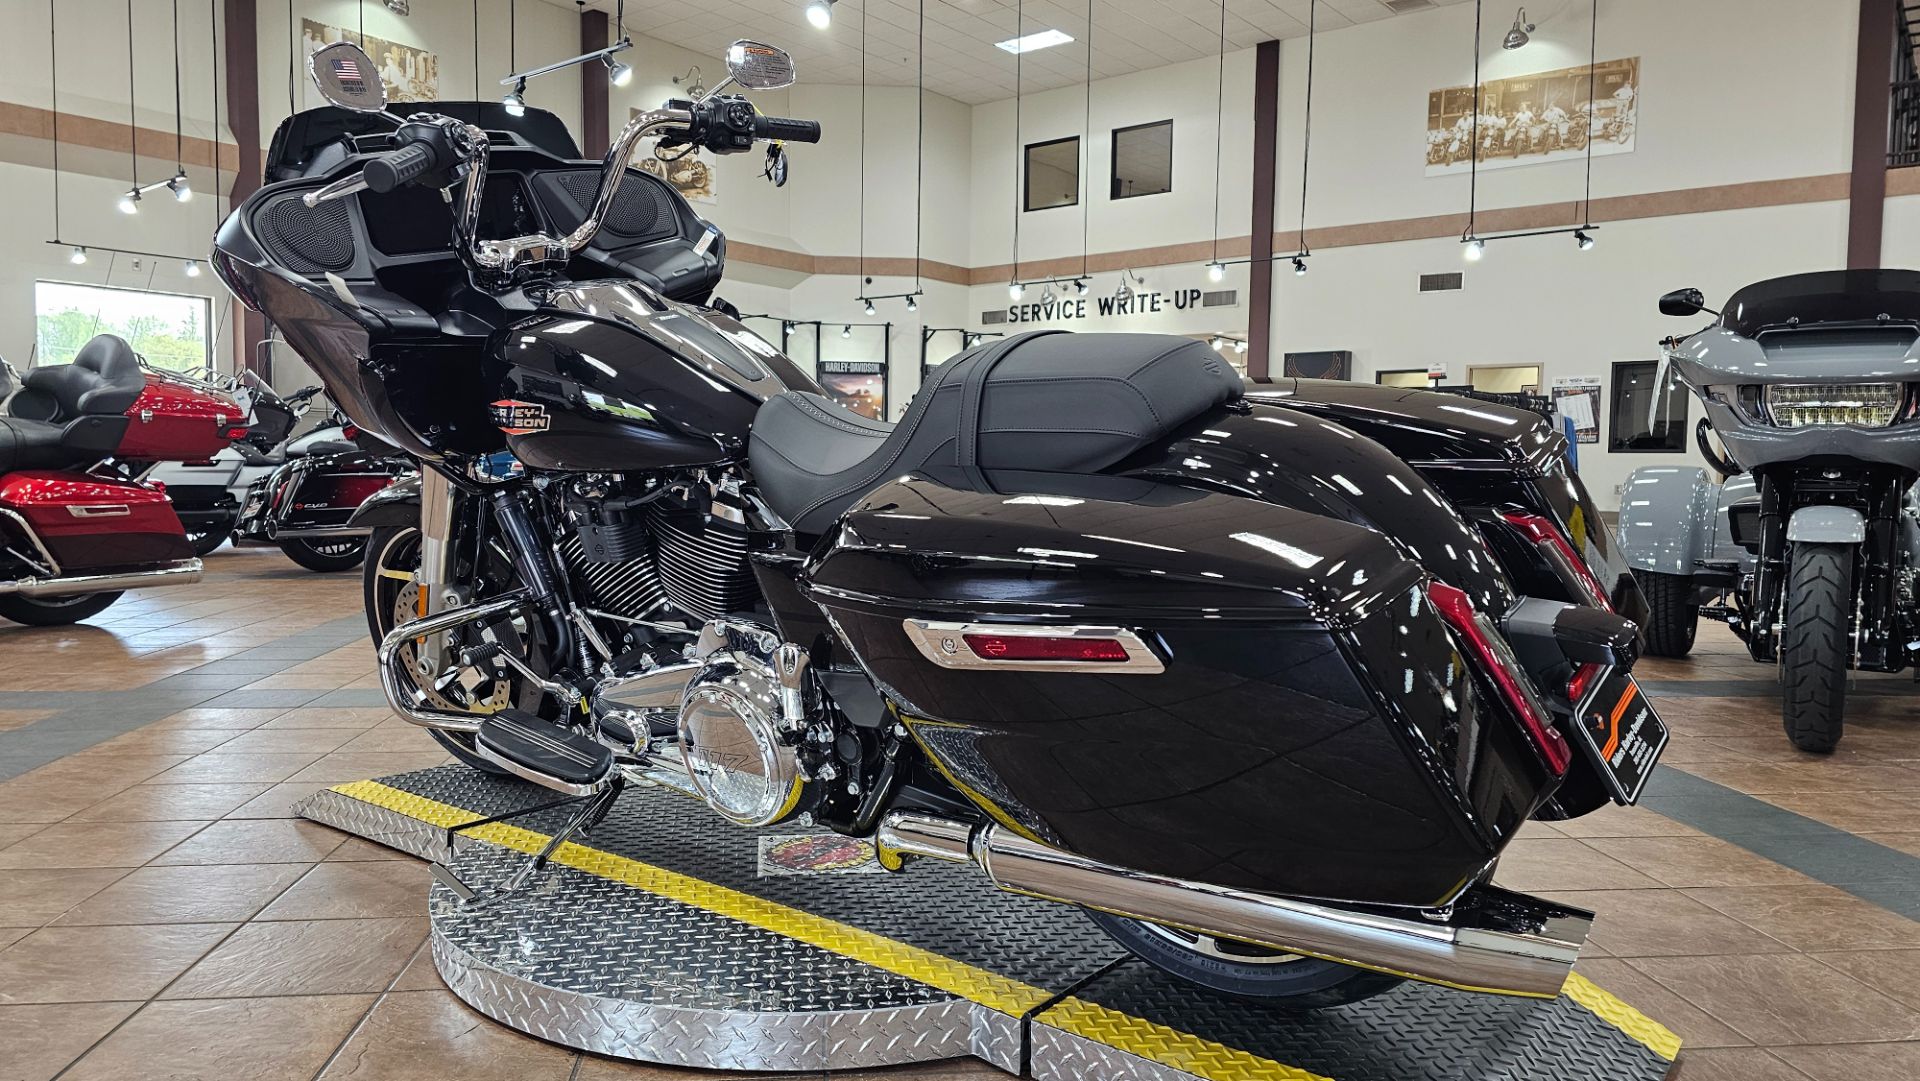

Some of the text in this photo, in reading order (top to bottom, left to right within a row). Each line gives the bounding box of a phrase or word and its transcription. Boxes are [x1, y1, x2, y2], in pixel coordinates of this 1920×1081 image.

[1008, 289, 1201, 323] SERVICE WRITE-UP
[825, 362, 880, 373] HARLEY-DAVIDSON
[698, 748, 749, 773] 117
